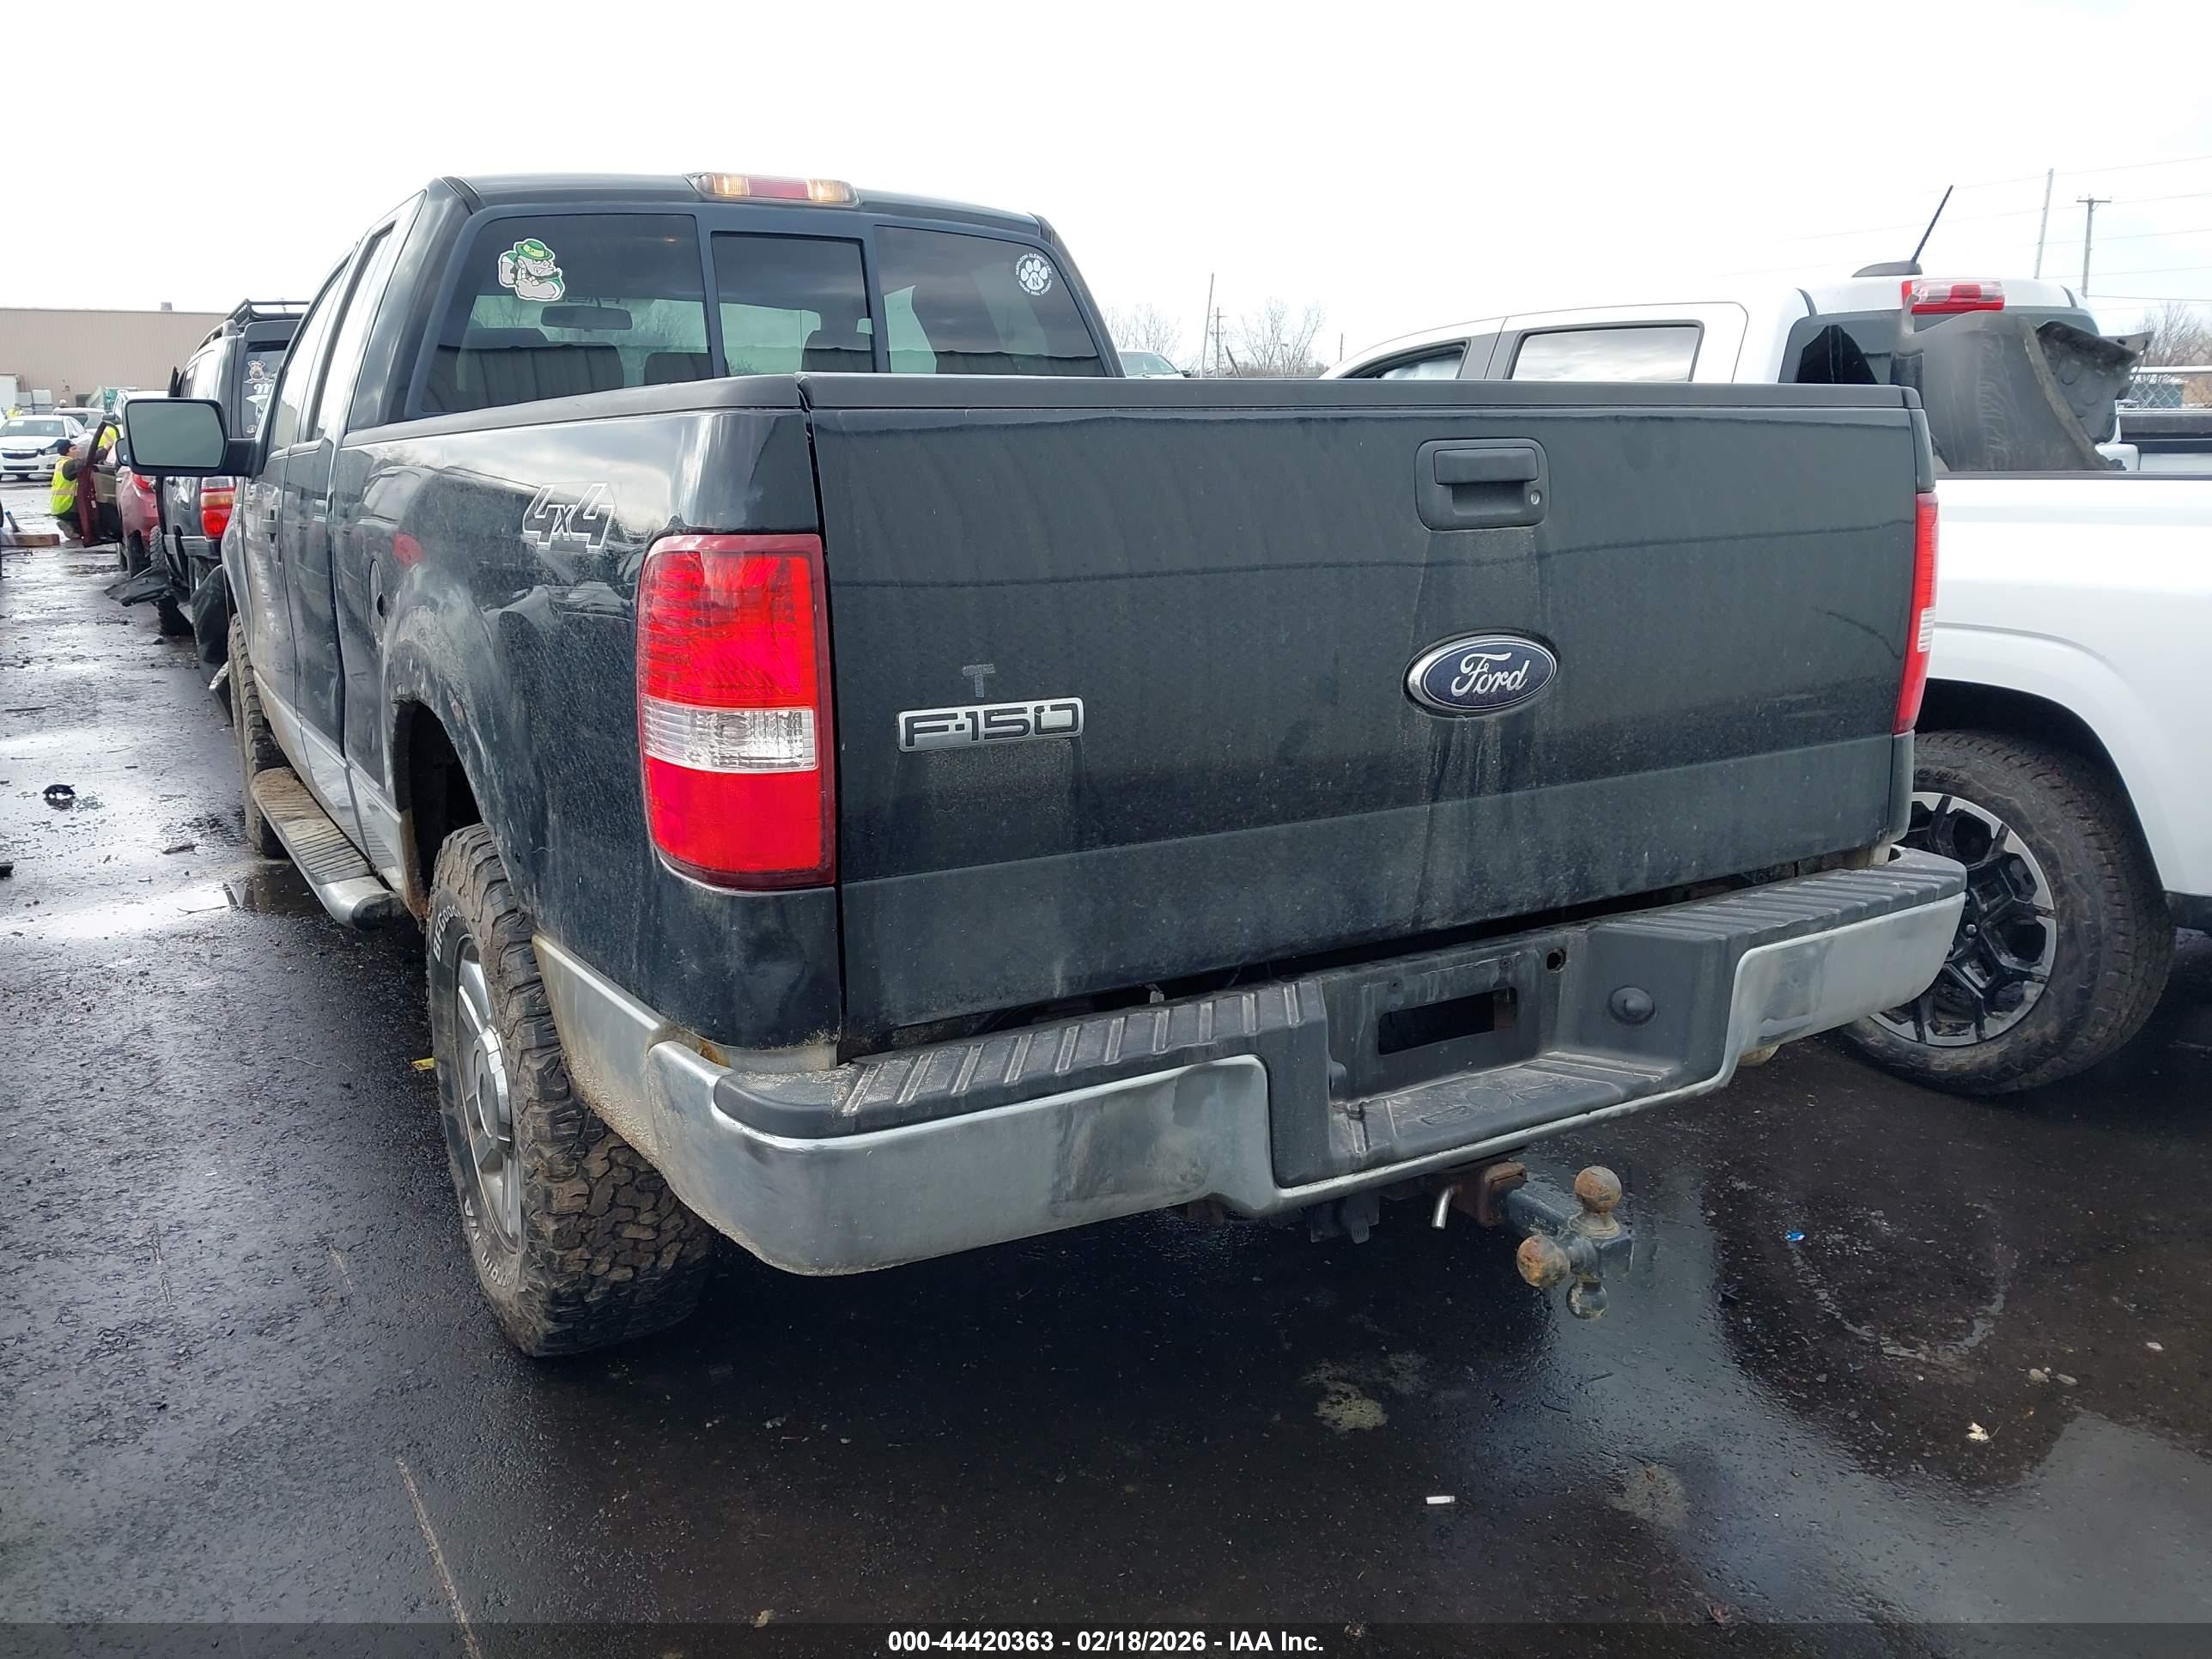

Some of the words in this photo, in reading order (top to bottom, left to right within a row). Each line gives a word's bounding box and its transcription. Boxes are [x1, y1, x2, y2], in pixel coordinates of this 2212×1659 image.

[1031, 276, 1040, 288] N
[1450, 652, 1531, 697] Ford
[902, 701, 1081, 749] F-150
